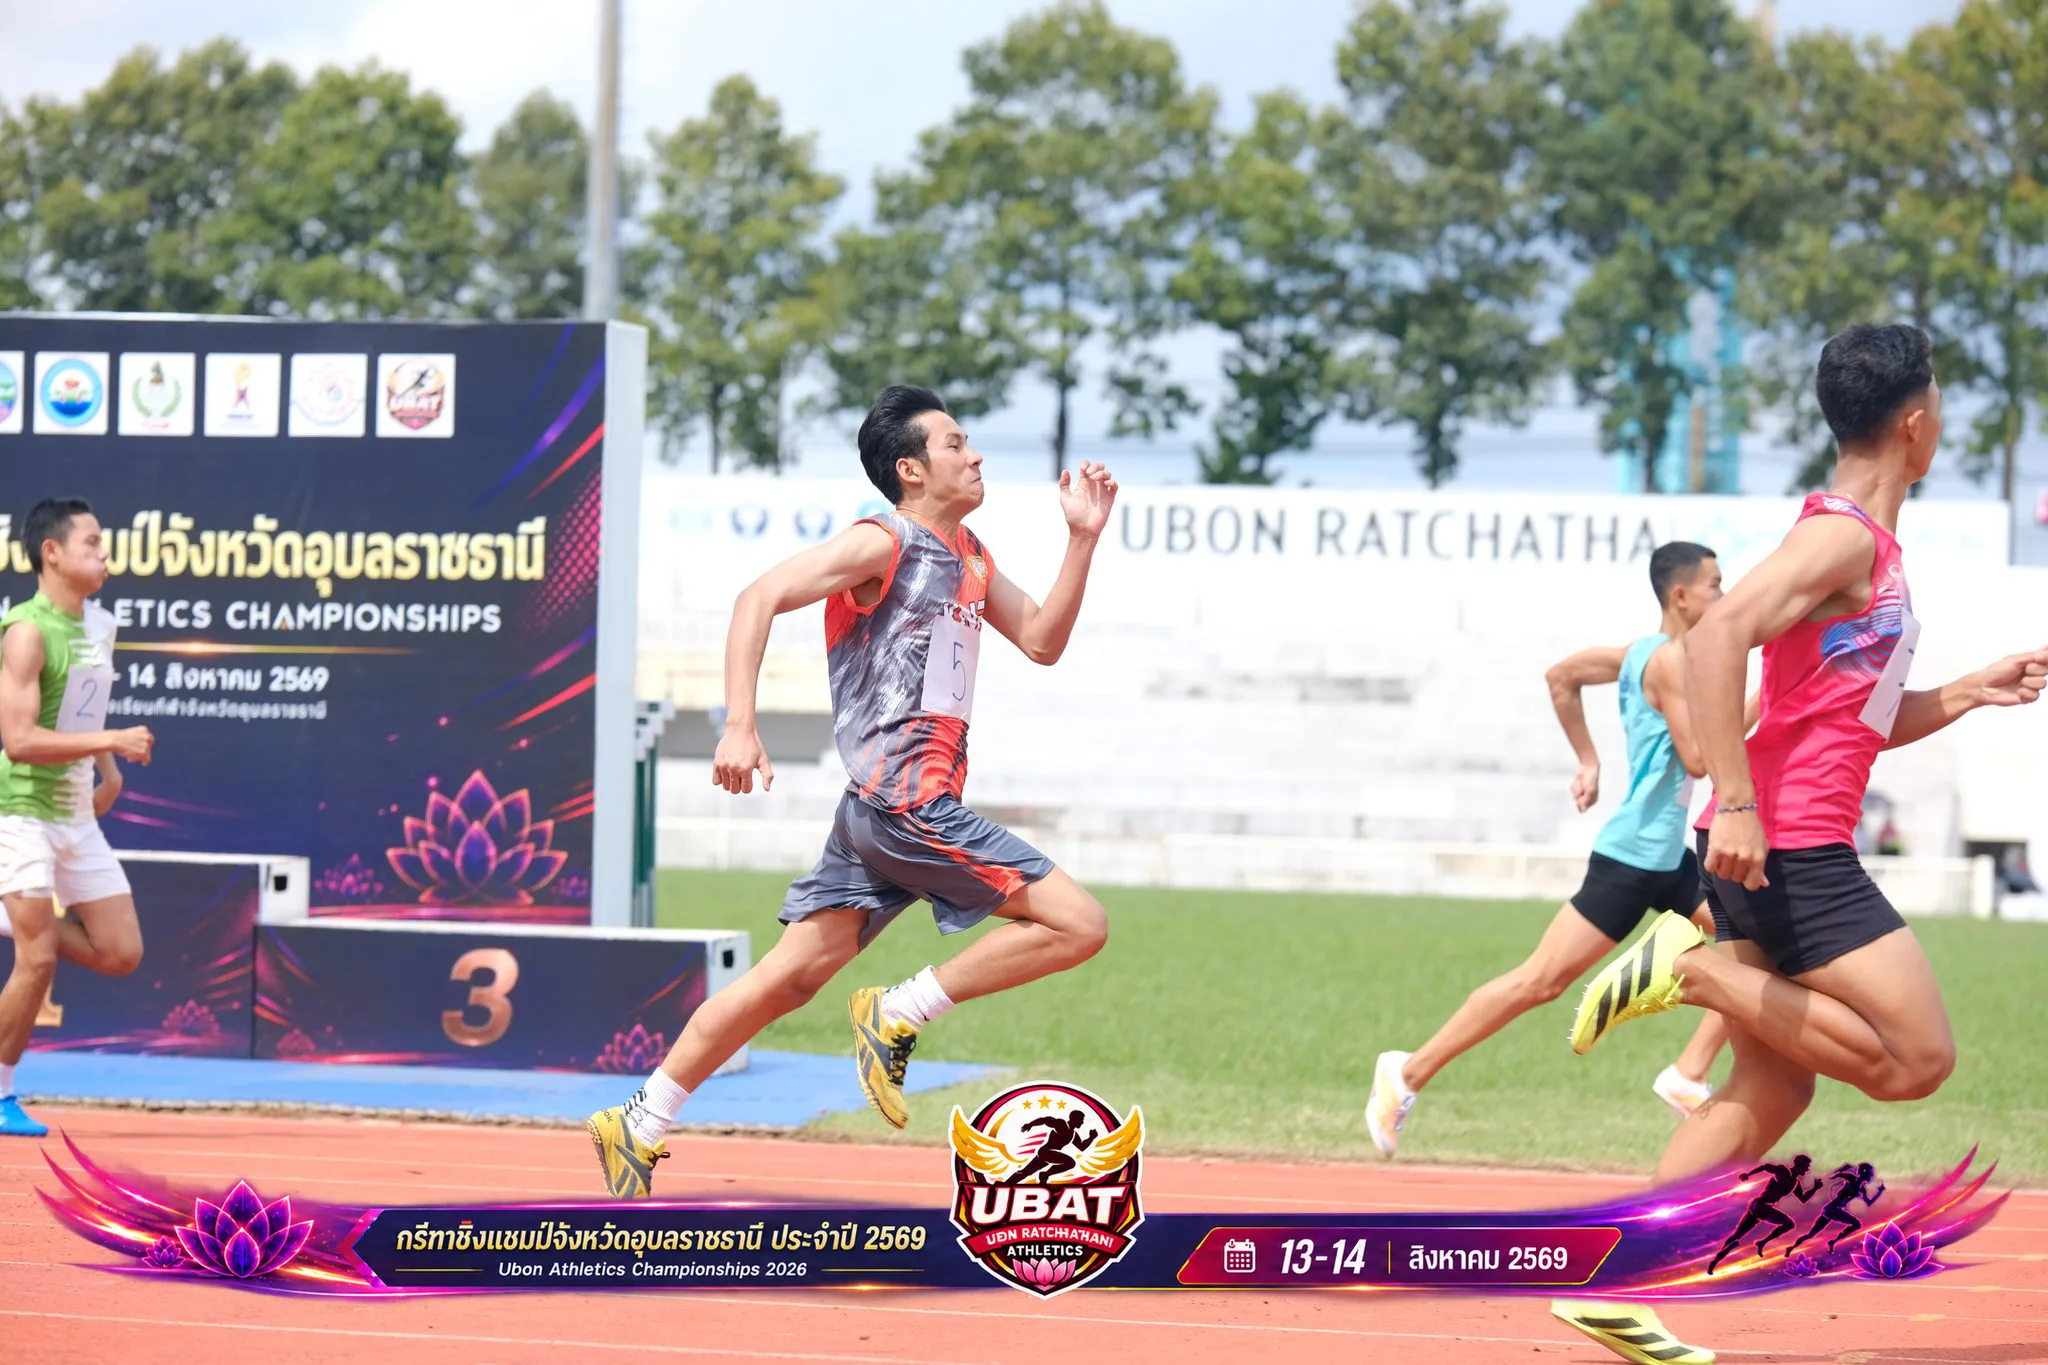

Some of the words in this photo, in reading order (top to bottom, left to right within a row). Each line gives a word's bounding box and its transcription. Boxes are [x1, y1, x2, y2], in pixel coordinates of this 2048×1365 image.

[1121, 503, 1287, 555] UBON
[1316, 507, 1658, 563] RATCHATHA
[225, 600, 502, 634] CHAMPIONSHIPS
[128, 662, 157, 688] 14
[165, 661, 262, 691] สิงหาคม
[268, 665, 330, 692] 2569
[951, 640, 967, 702] 5
[75, 677, 98, 718] 2
[442, 947, 520, 1047] 3
